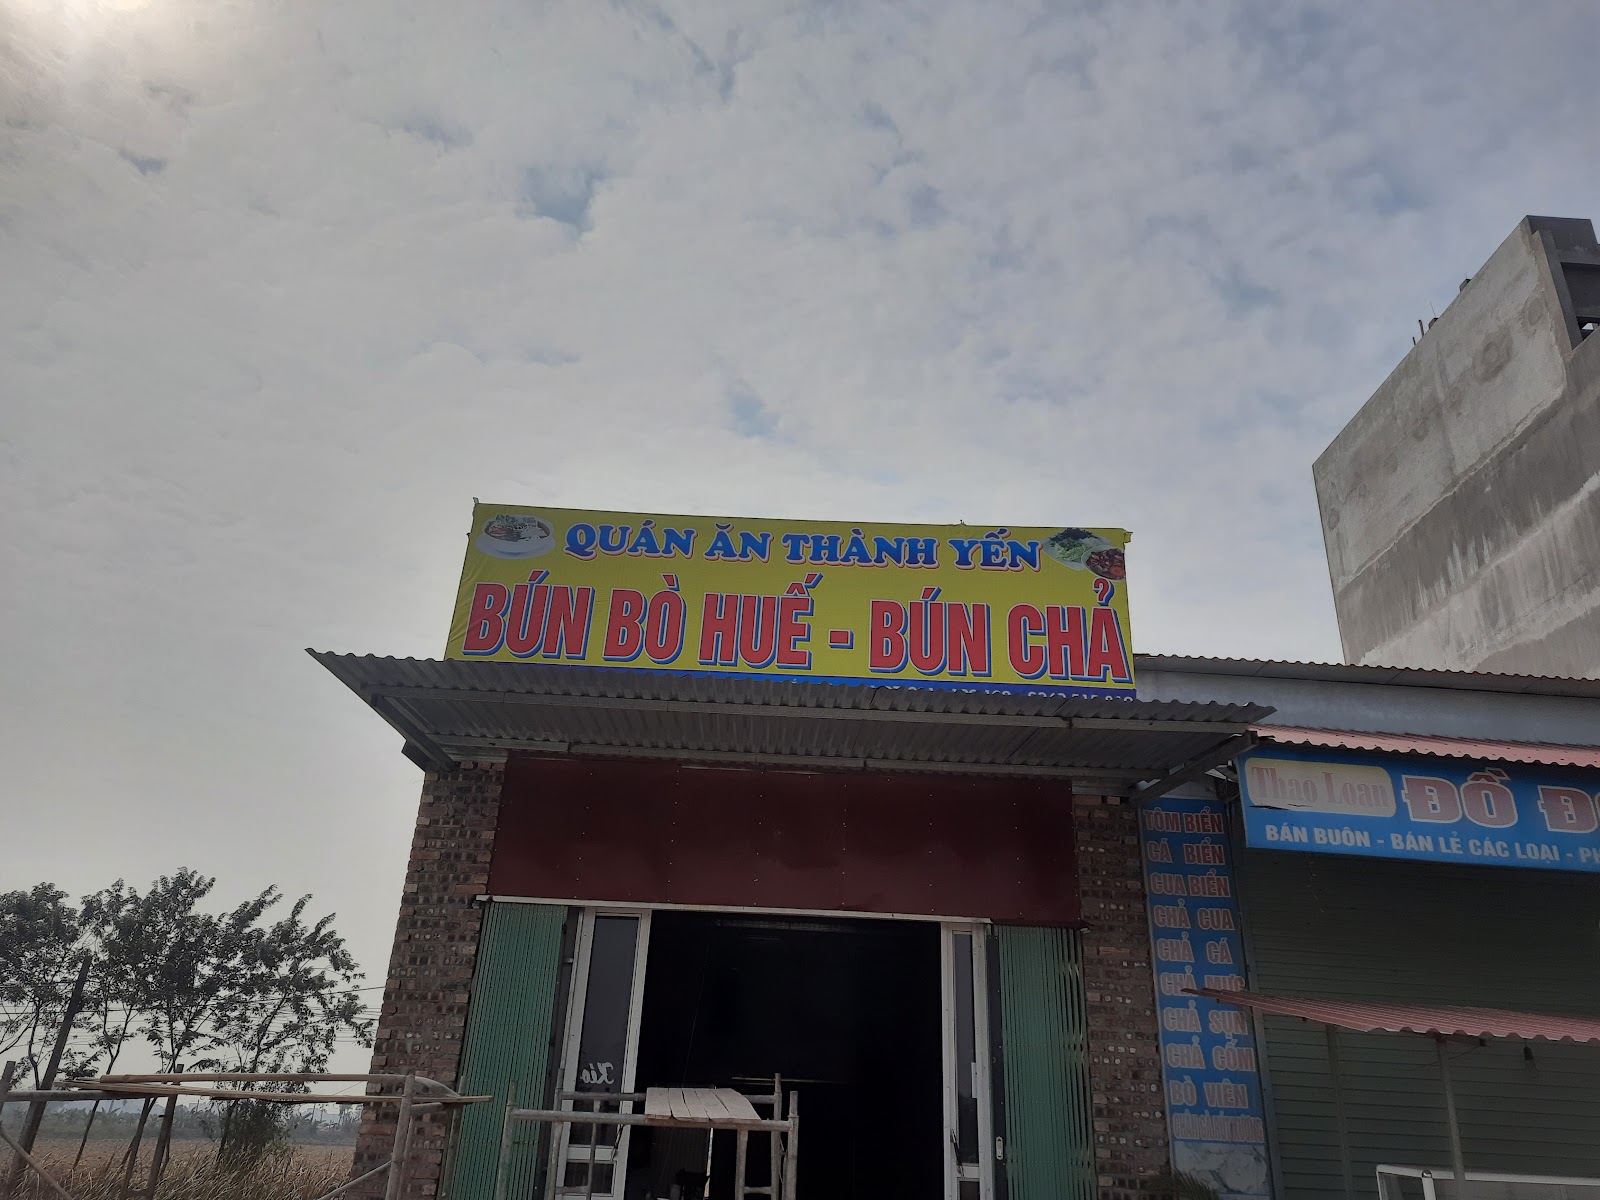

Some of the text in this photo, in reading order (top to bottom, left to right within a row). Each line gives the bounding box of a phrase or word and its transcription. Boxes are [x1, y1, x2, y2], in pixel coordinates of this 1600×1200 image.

[564, 519, 1042, 572] QUÁN ĂN THÀNH YẾN
[461, 569, 1133, 684] BÚN BÒ HUẾ - BÚN CHẢ
[1251, 766, 1391, 808] Thao Loan
[1400, 767, 1600, 833] ĐỒ Đ
[1144, 806, 1224, 834] TÔM BIỂN
[1147, 837, 1225, 865] CÁ BIỂN
[1265, 823, 1308, 844] BÁN
[1314, 826, 1371, 848] BUÔN
[1391, 832, 1434, 852] BÁN
[1439, 831, 1464, 854] LẺ
[1468, 837, 1510, 858] CÁC
[1514, 842, 1560, 864] LOẠI
[1150, 868, 1230, 898] CUA BIỂN
[1154, 898, 1234, 930] CHẢ CUA
[1157, 932, 1233, 964] CHẢ CÁ
[1160, 965, 1198, 996] CHẢ
[1164, 1000, 1248, 1039] CHẢ SỤN
[1166, 1036, 1256, 1072] CHẢ CỐM
[1170, 1076, 1248, 1109] BÒ VIÊN
